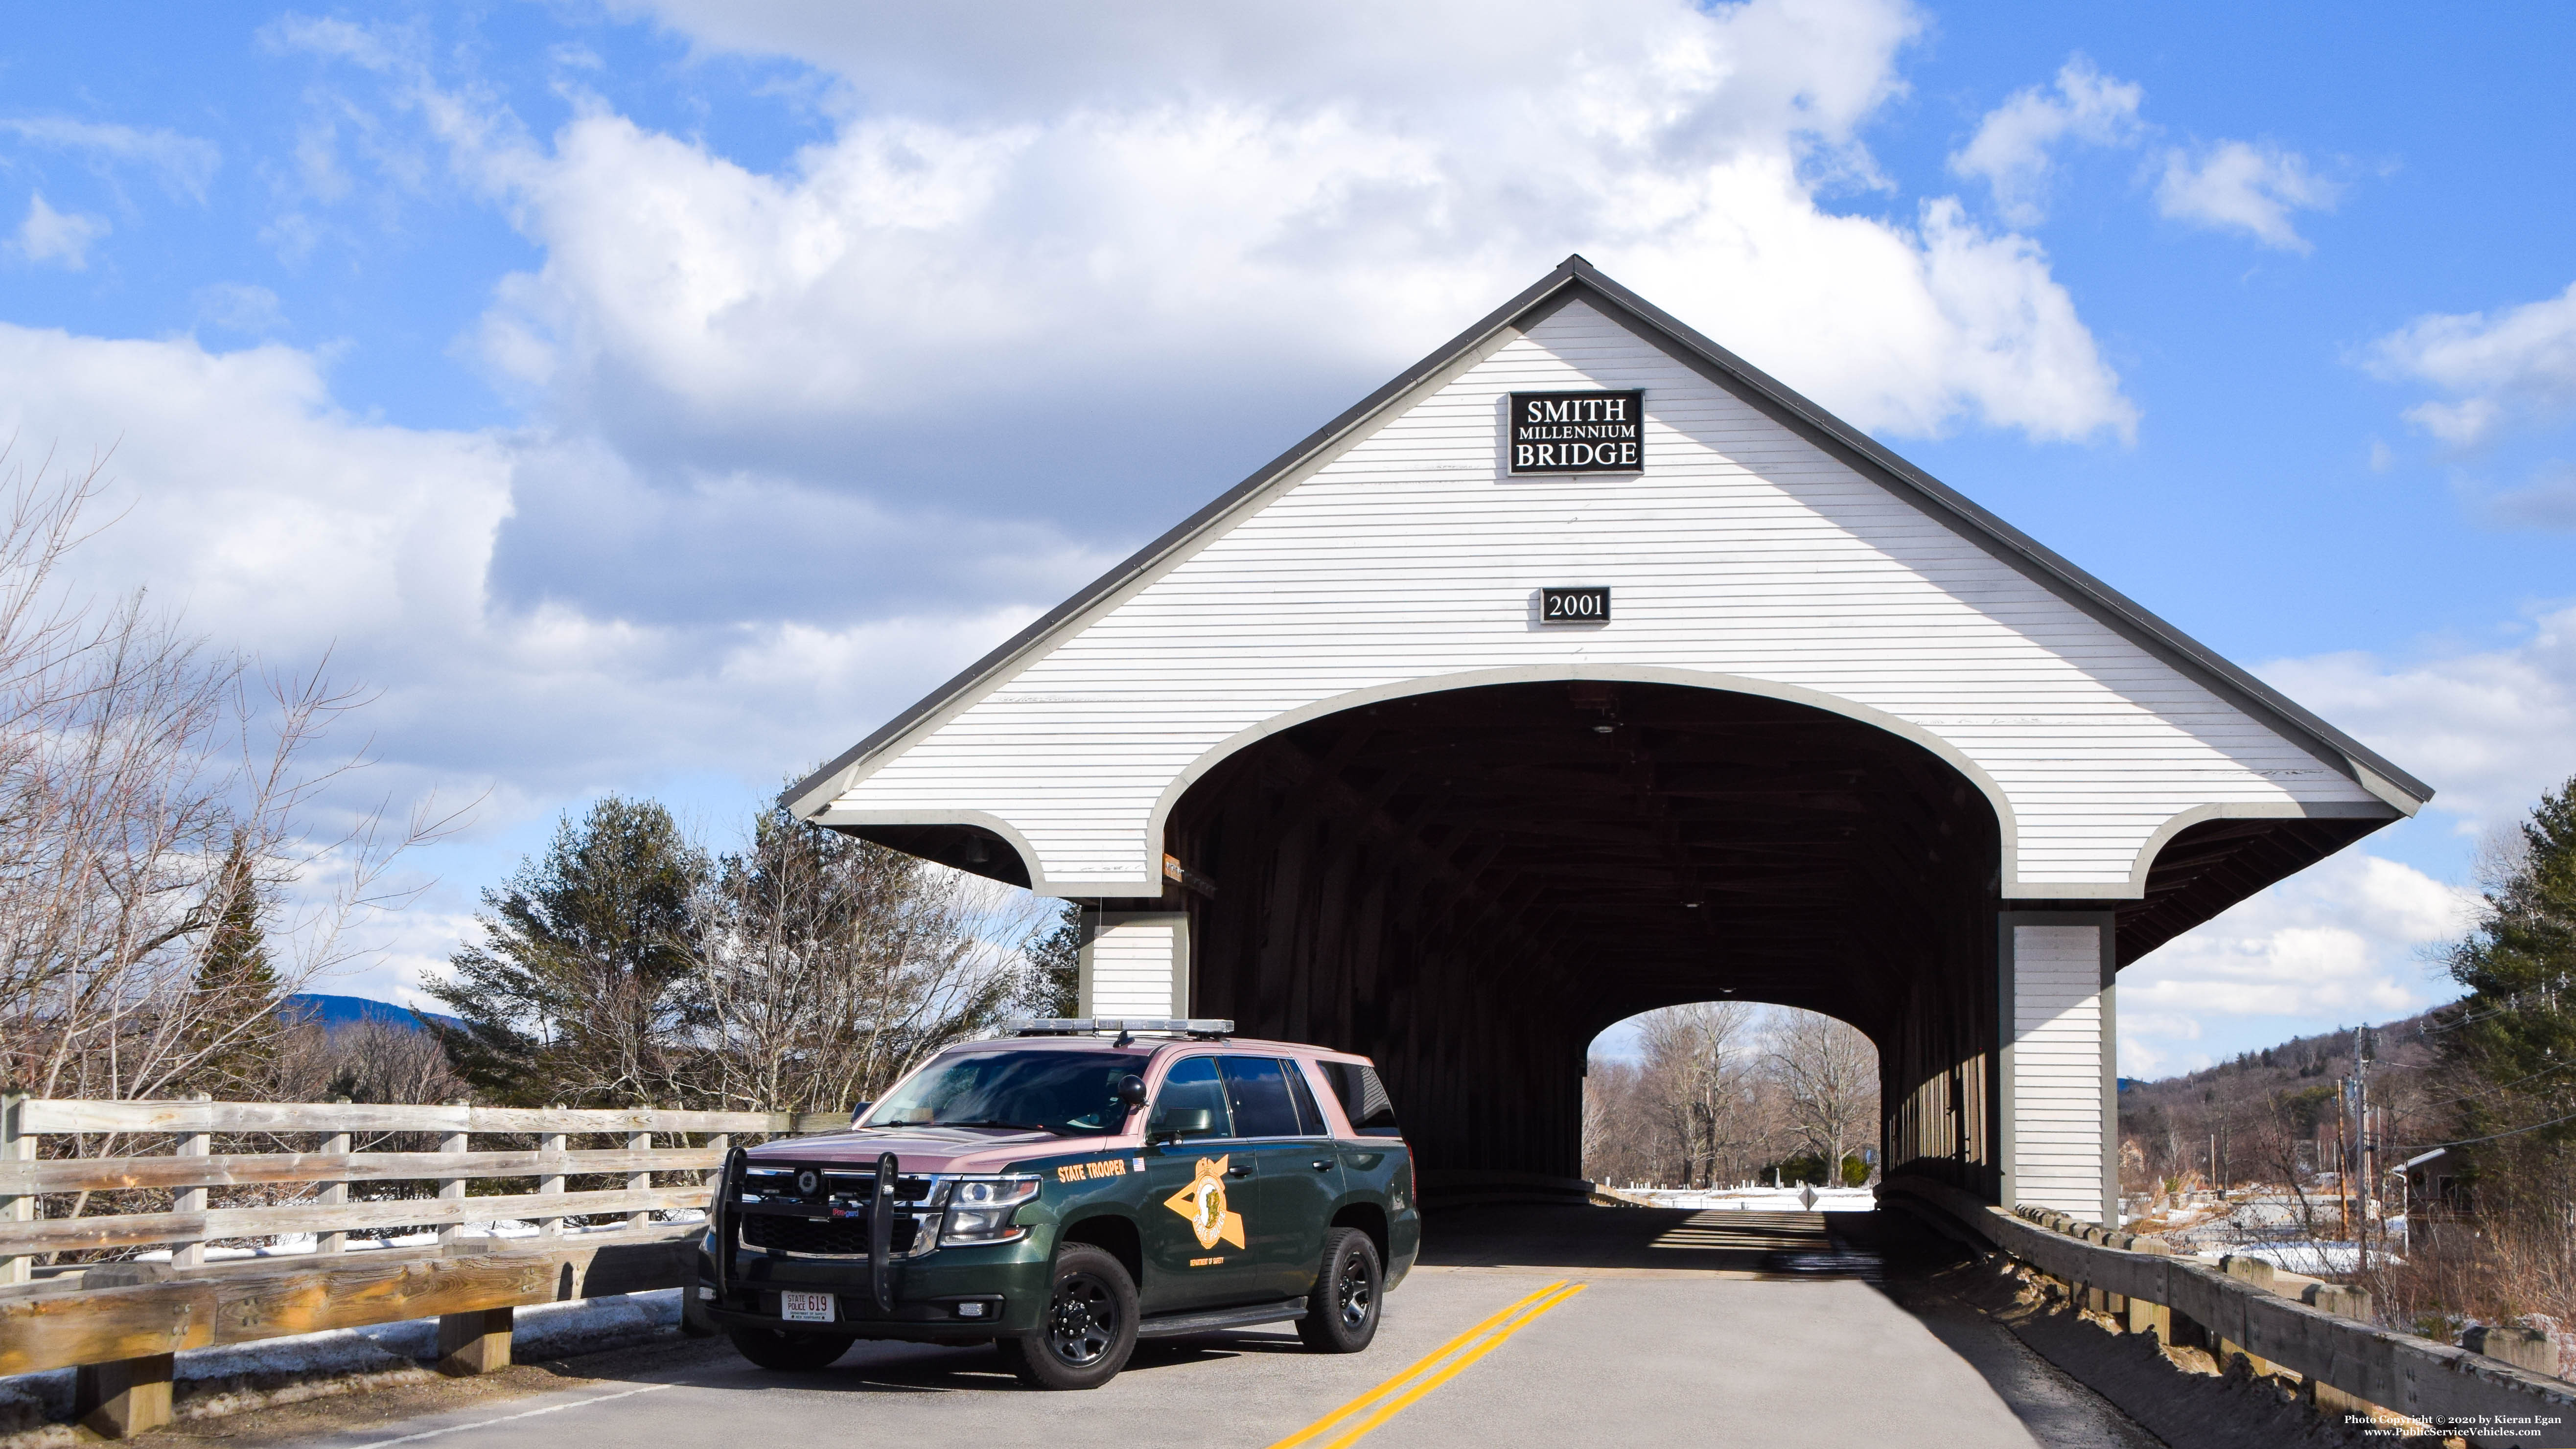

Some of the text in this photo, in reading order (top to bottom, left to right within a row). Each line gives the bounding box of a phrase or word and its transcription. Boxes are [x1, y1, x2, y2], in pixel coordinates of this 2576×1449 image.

[1528, 399, 1626, 423] SMITH
[1519, 425, 1636, 439] MILLENNIUM
[1516, 442, 1638, 466] BRIDGE
[1550, 595, 1602, 616] 2001
[1058, 1159, 1126, 1183] STATE TROOPER
[1194, 1211, 1226, 1242] STATE POLICE
[809, 1295, 827, 1311] 619
